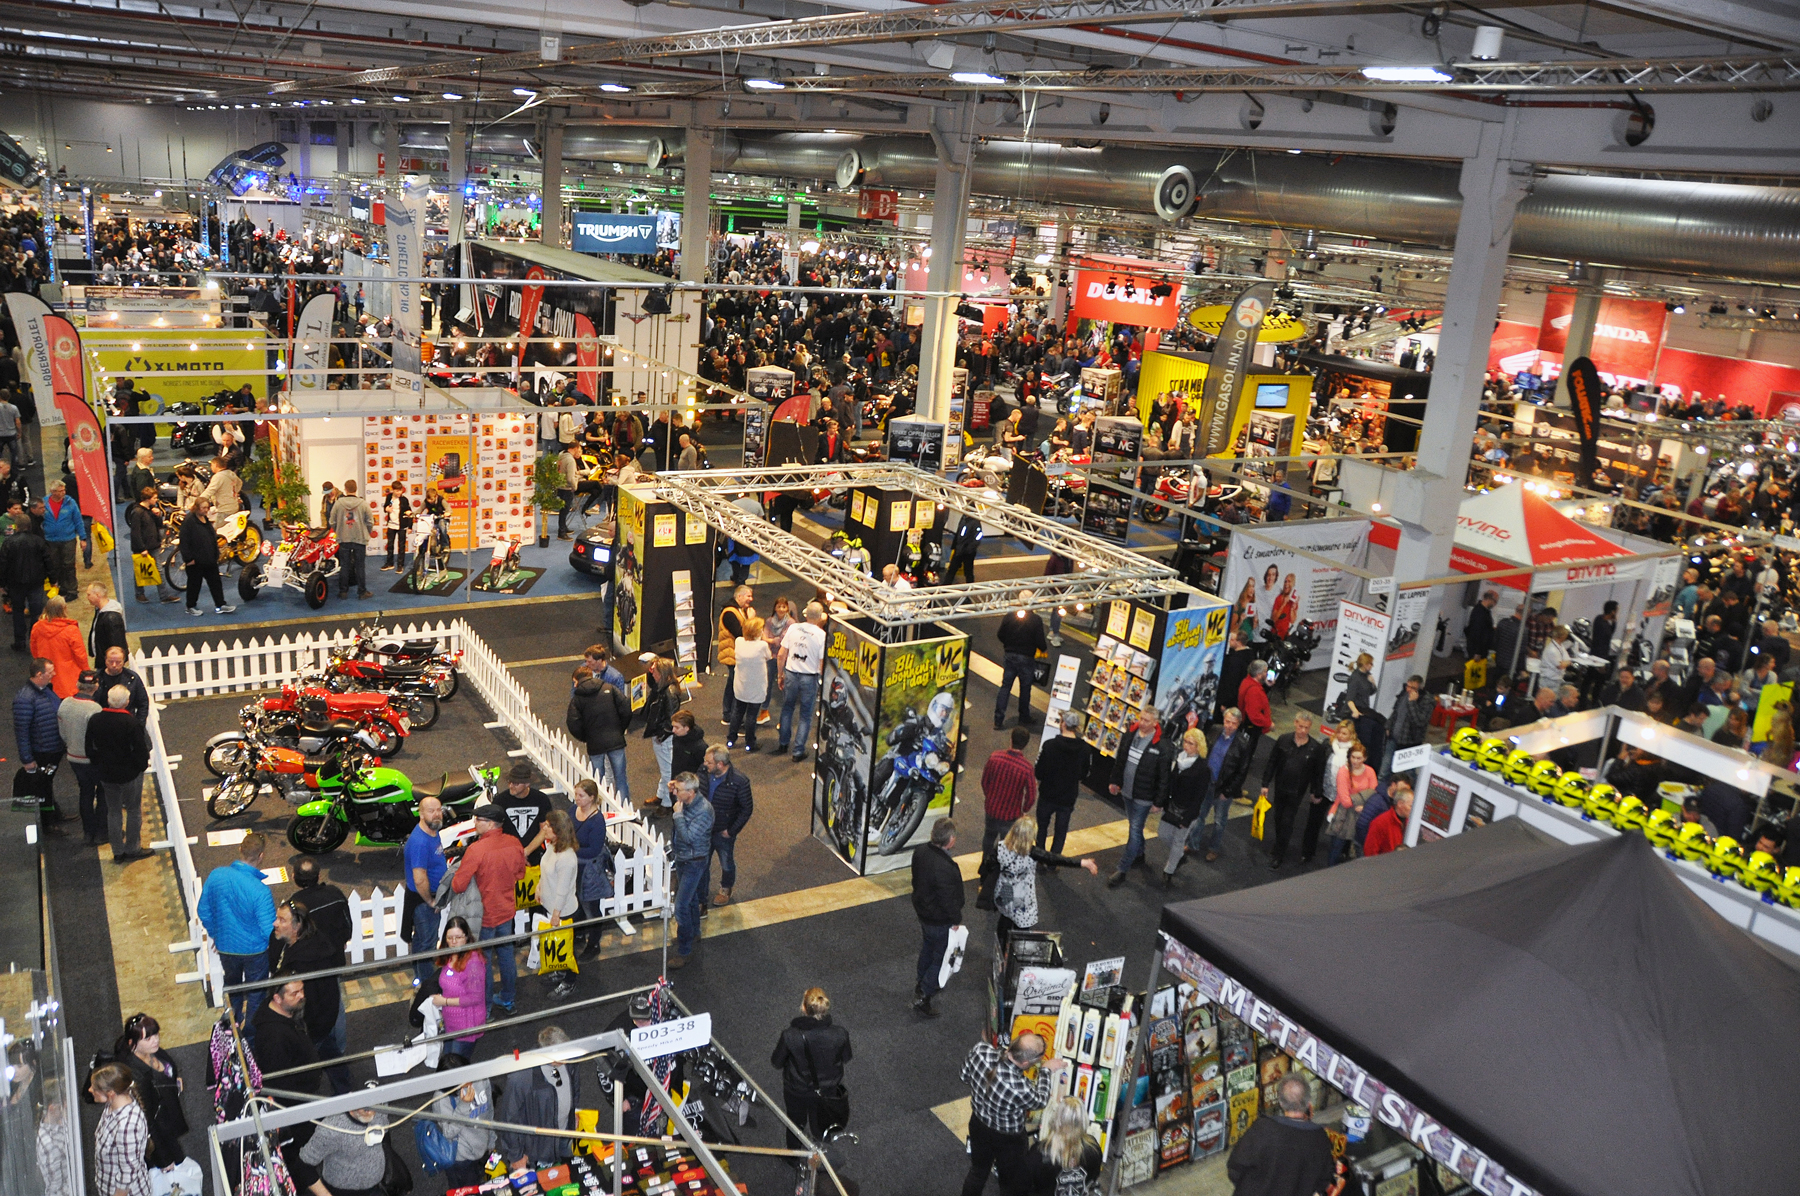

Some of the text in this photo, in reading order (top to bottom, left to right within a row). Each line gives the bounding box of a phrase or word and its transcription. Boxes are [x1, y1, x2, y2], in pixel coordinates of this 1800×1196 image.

[880, 193, 890, 216] D
[577, 223, 638, 242] TRIUMPH
[1593, 323, 1650, 344] ONDA
[154, 362, 224, 371] XLMOTO
[1208, 329, 1247, 449] WWW.GASOLIN.NO
[1175, 618, 1190, 634] Bli
[1208, 611, 1226, 635] MC
[1344, 608, 1385, 629] DRIVING
[833, 632, 847, 651] Bli
[827, 647, 858, 662] abonnent
[860, 645, 878, 678] MC
[894, 653, 915, 672] Bli
[937, 645, 964, 677] MC
[841, 656, 858, 676] dag!
[885, 659, 930, 687] abonnent
[909, 663, 935, 688] dag!
[939, 673, 959, 681] avisa
[1397, 748, 1424, 760] D03-36
[515, 879, 536, 906] MC
[543, 938, 568, 968] MC
[548, 962, 568, 970] avisa
[1023, 979, 1068, 999] Original
[638, 1020, 696, 1042] D03-38
